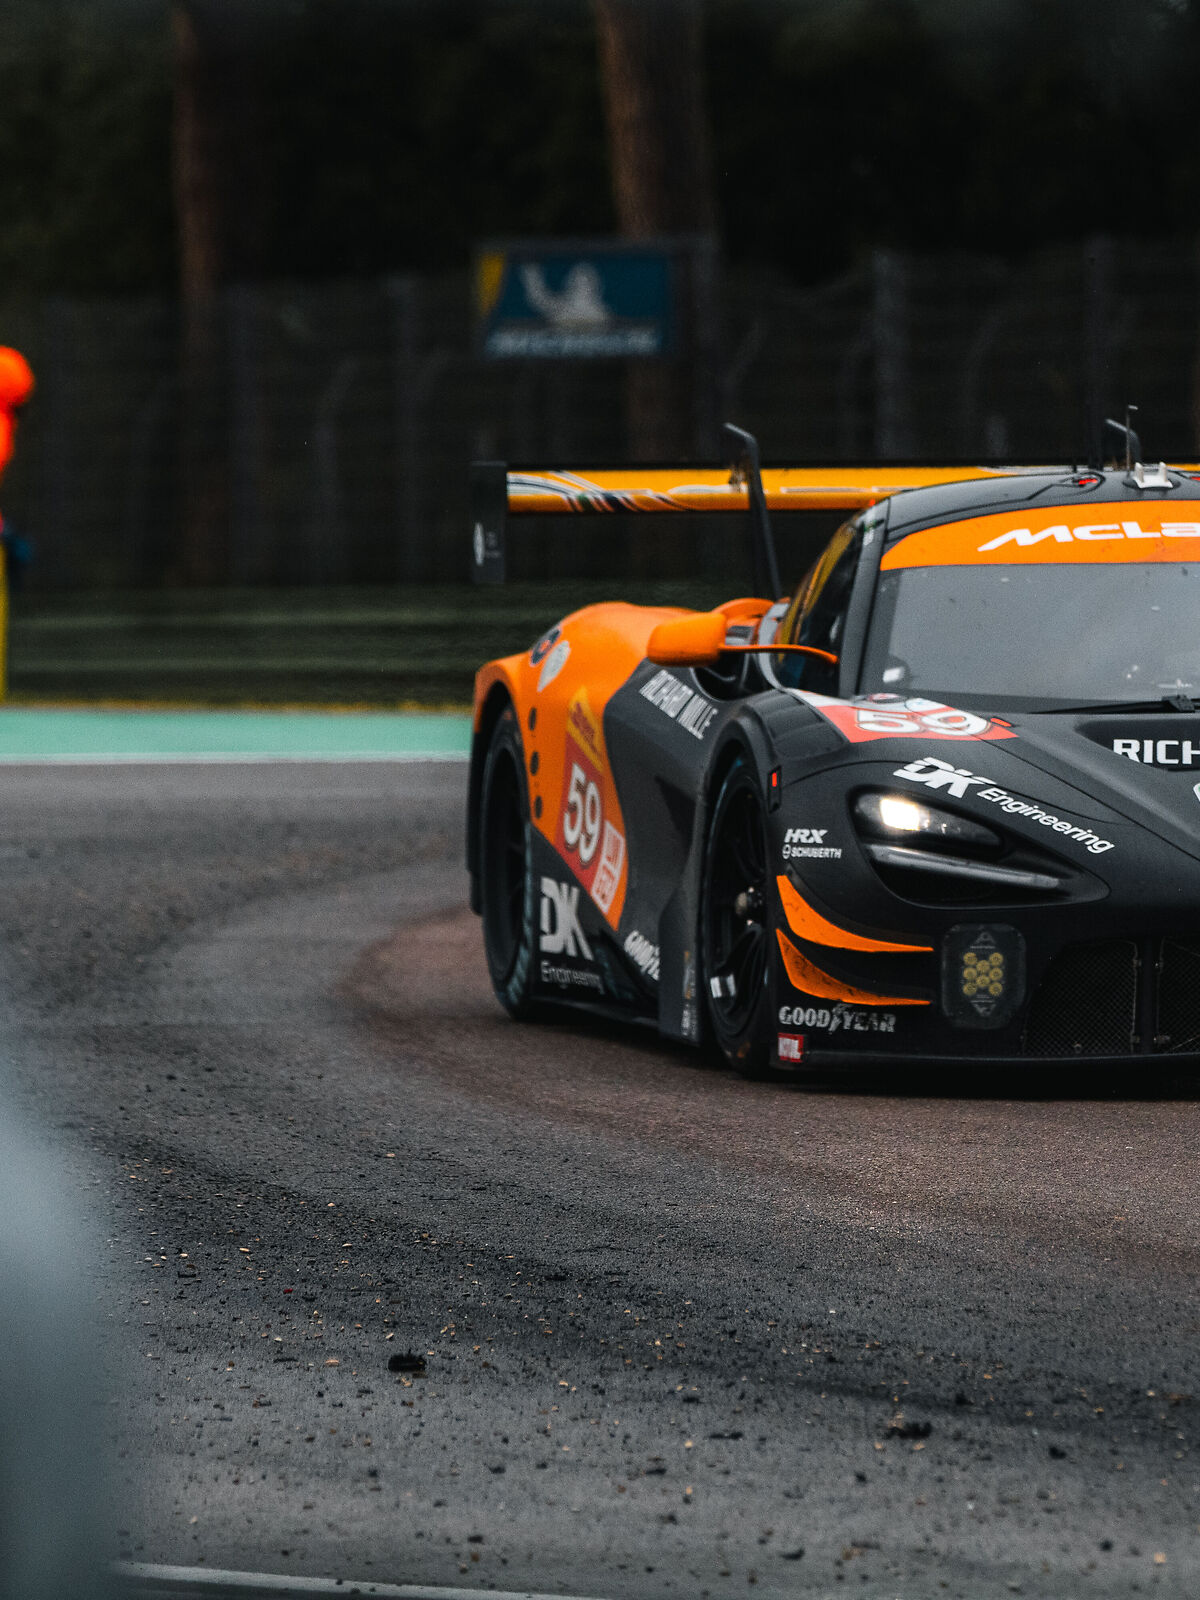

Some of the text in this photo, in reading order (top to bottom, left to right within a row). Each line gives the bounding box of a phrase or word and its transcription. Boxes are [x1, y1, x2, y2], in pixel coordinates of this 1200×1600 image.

[856, 708, 991, 737] 59
[563, 762, 601, 863] 59
[893, 756, 1115, 855] DK Engineering
[784, 828, 828, 845] HRX
[790, 848, 842, 860] SCHUBERTH
[540, 876, 595, 962] DK
[778, 1003, 897, 1034] GOODYEAR
